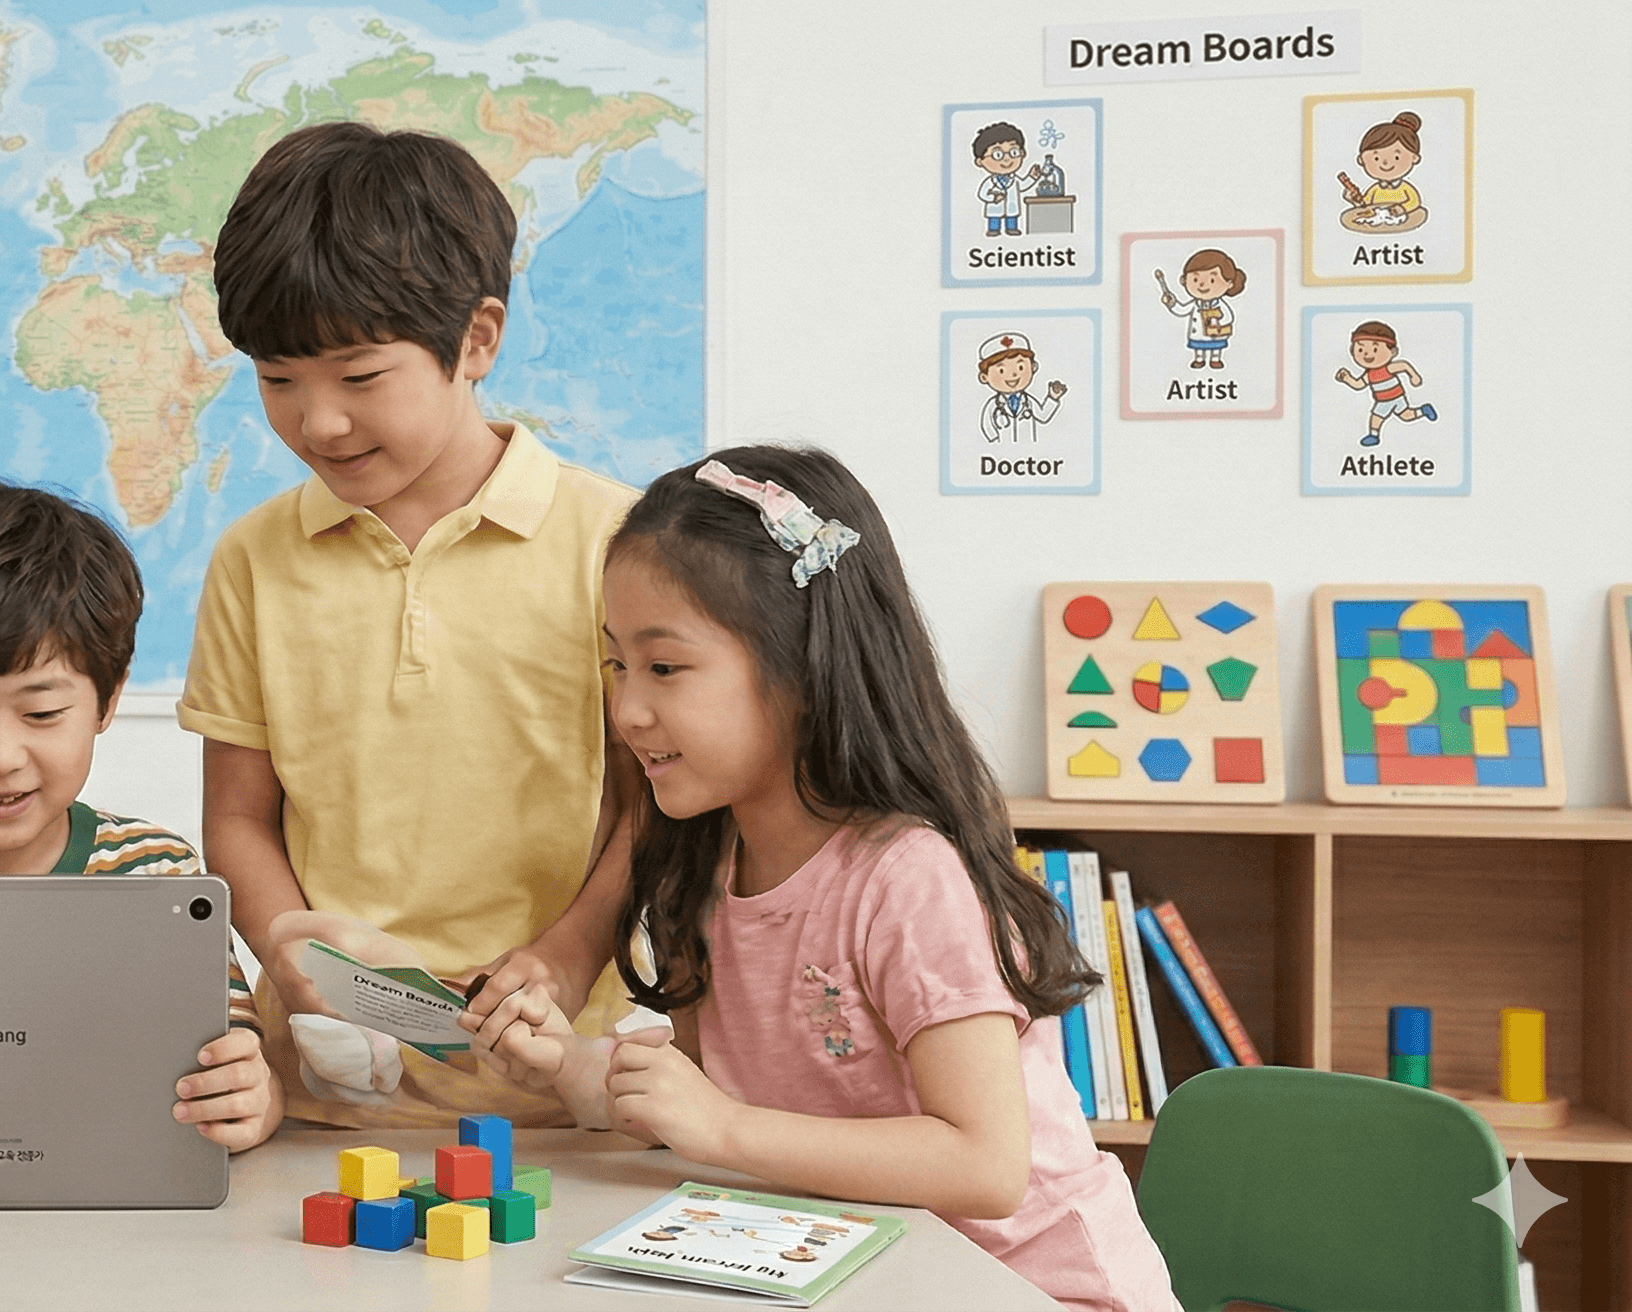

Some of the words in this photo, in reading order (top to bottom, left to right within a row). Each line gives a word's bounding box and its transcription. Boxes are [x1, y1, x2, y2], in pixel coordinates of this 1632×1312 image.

[1070, 38, 1191, 69] Dream
[1203, 26, 1335, 63] Boards
[968, 244, 1077, 269] Scientist
[1352, 243, 1425, 266] Artist
[1166, 377, 1238, 401] Artist
[980, 455, 1064, 477] Doctor
[1340, 453, 1435, 477] Athlete
[354, 974, 403, 997] Dream
[405, 991, 454, 1013] Boards
